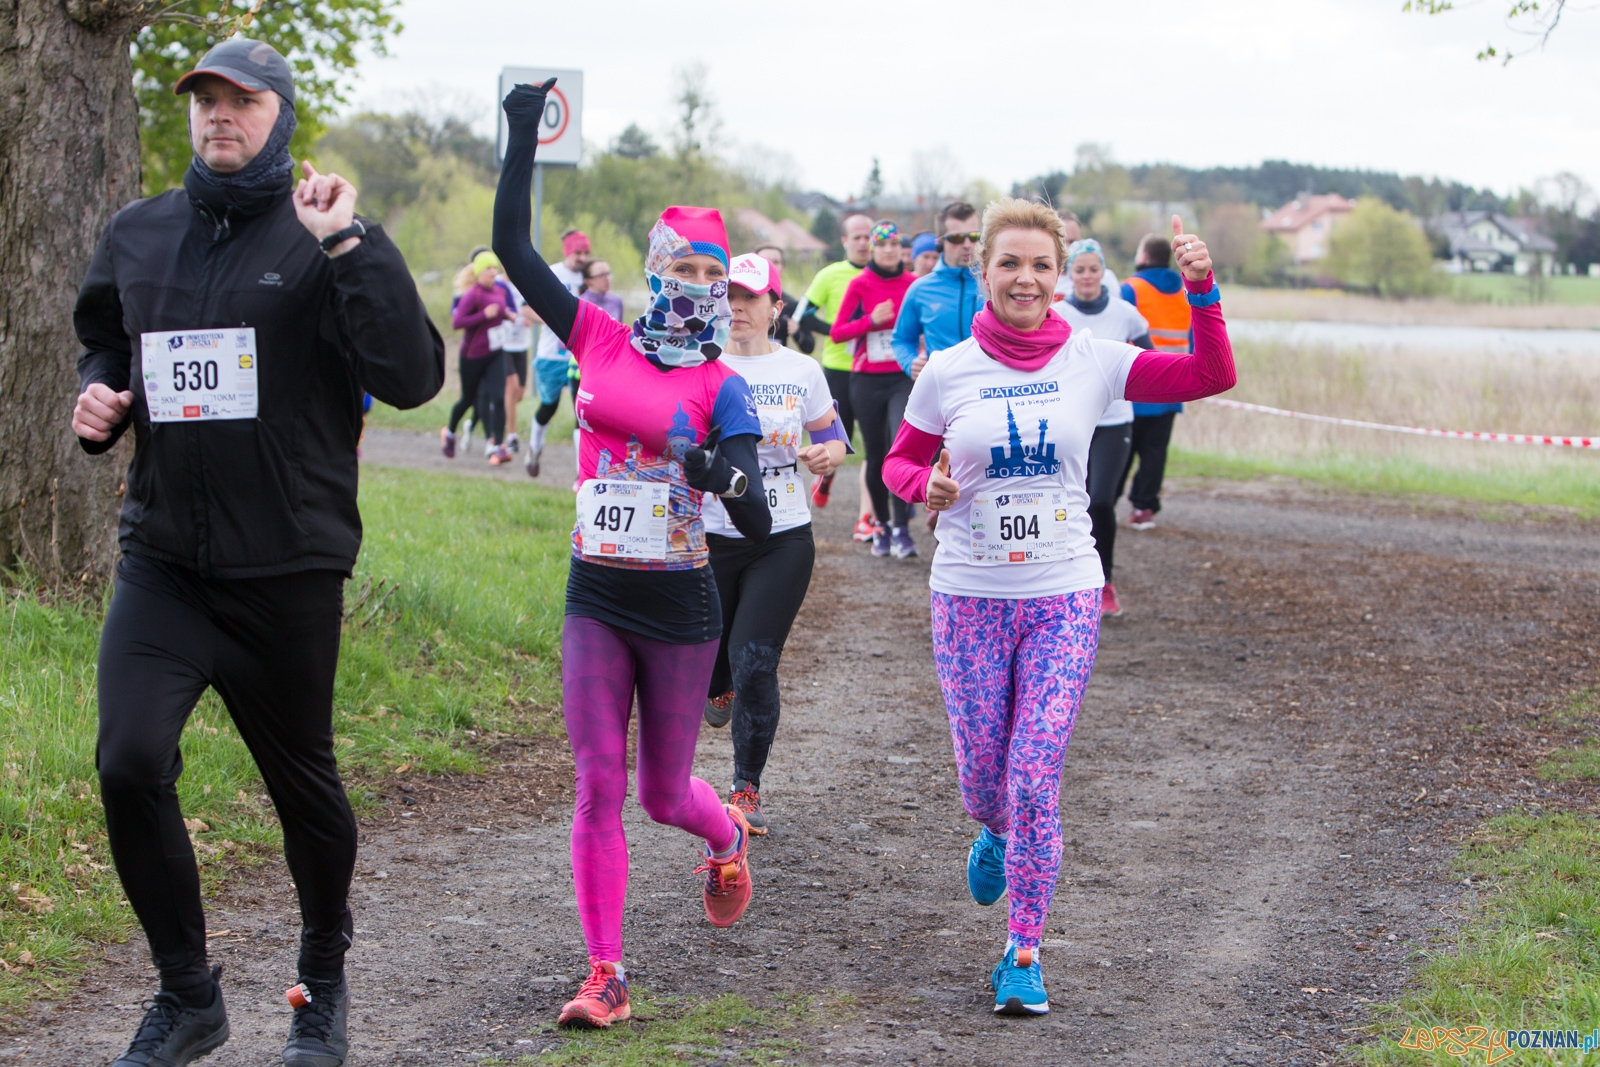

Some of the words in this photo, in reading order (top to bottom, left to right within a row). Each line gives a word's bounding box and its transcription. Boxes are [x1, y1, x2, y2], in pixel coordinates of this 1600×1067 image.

[544, 101, 560, 129] 0
[730, 267, 761, 276] adidas
[699, 304, 715, 315] TUT
[173, 360, 218, 392] 530
[750, 384, 808, 397] WERSYTECKA
[161, 395, 176, 404] 5KM
[213, 394, 236, 402] 10KM
[785, 395, 798, 411] IV
[1028, 397, 1060, 406] biegowo
[594, 505, 635, 532] 497
[1000, 514, 1041, 541] 504
[1035, 541, 1054, 549] 10KM
